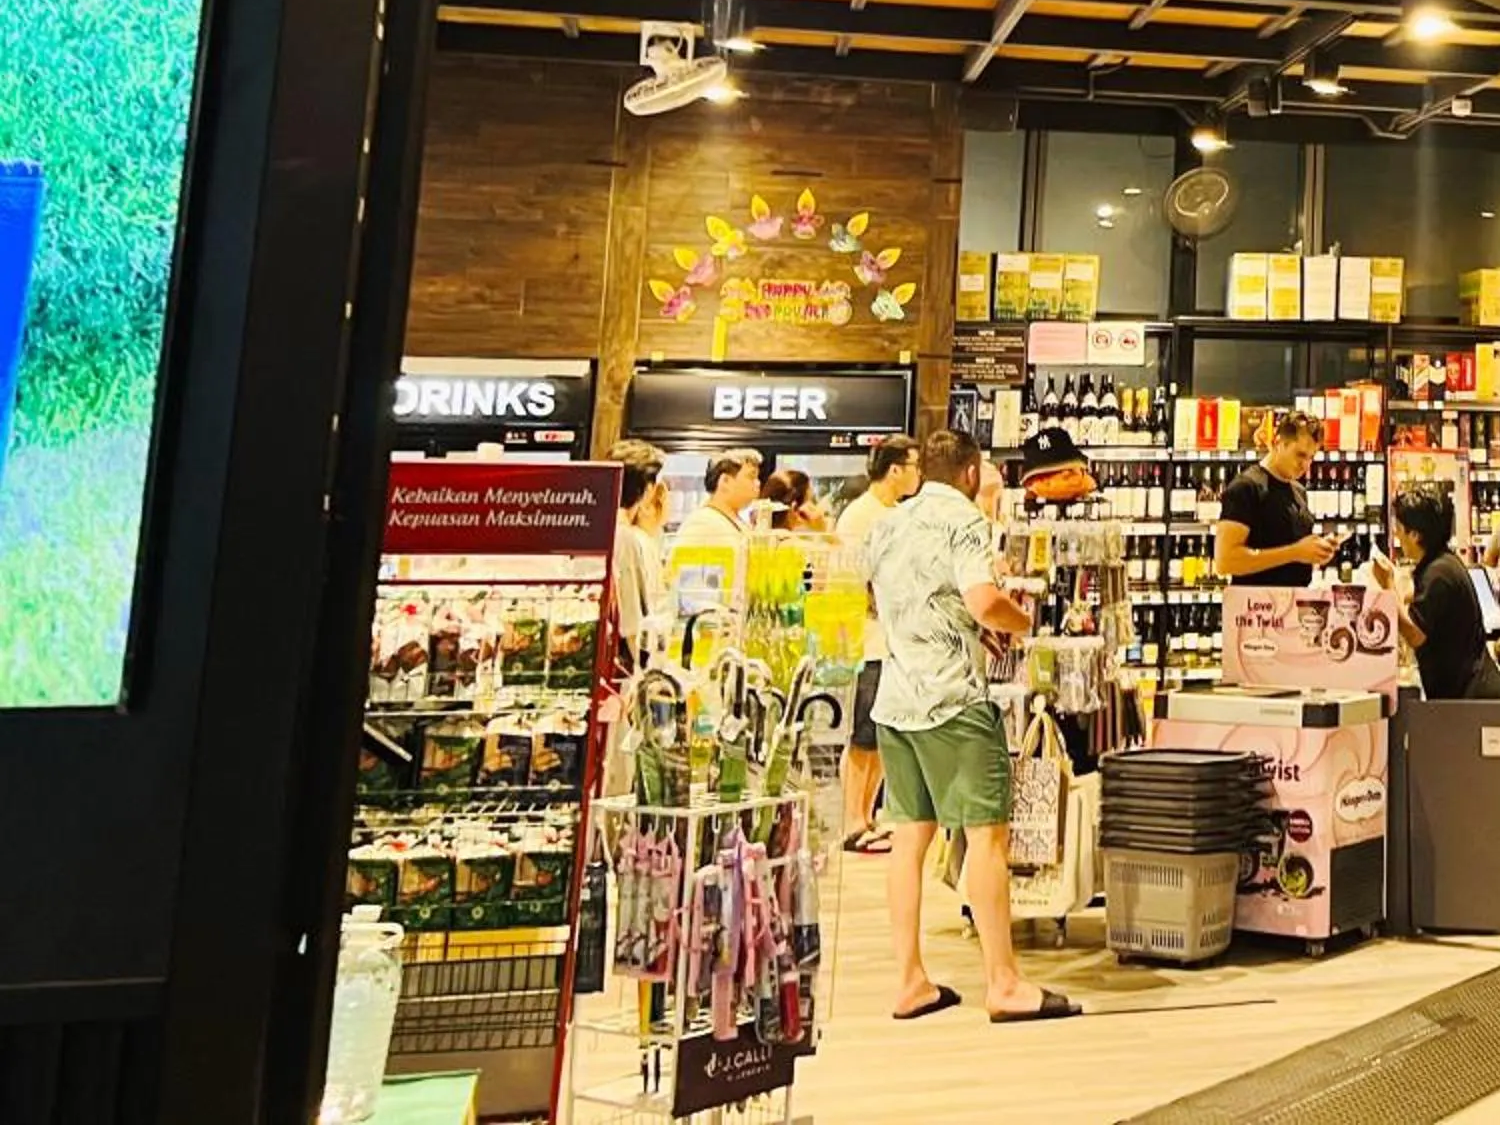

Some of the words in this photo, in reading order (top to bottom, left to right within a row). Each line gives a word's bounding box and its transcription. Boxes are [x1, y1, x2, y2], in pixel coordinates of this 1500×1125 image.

[393, 379, 556, 417] DRINKS
[713, 386, 828, 420] BEER
[391, 487, 479, 504] Kebaikan
[484, 487, 597, 507] Menyeluruh.
[388, 509, 480, 529] Kepuasan
[485, 509, 590, 527] Maksimum.
[1247, 598, 1273, 612] Love
[1235, 615, 1253, 628] the
[1256, 614, 1285, 628] Twist
